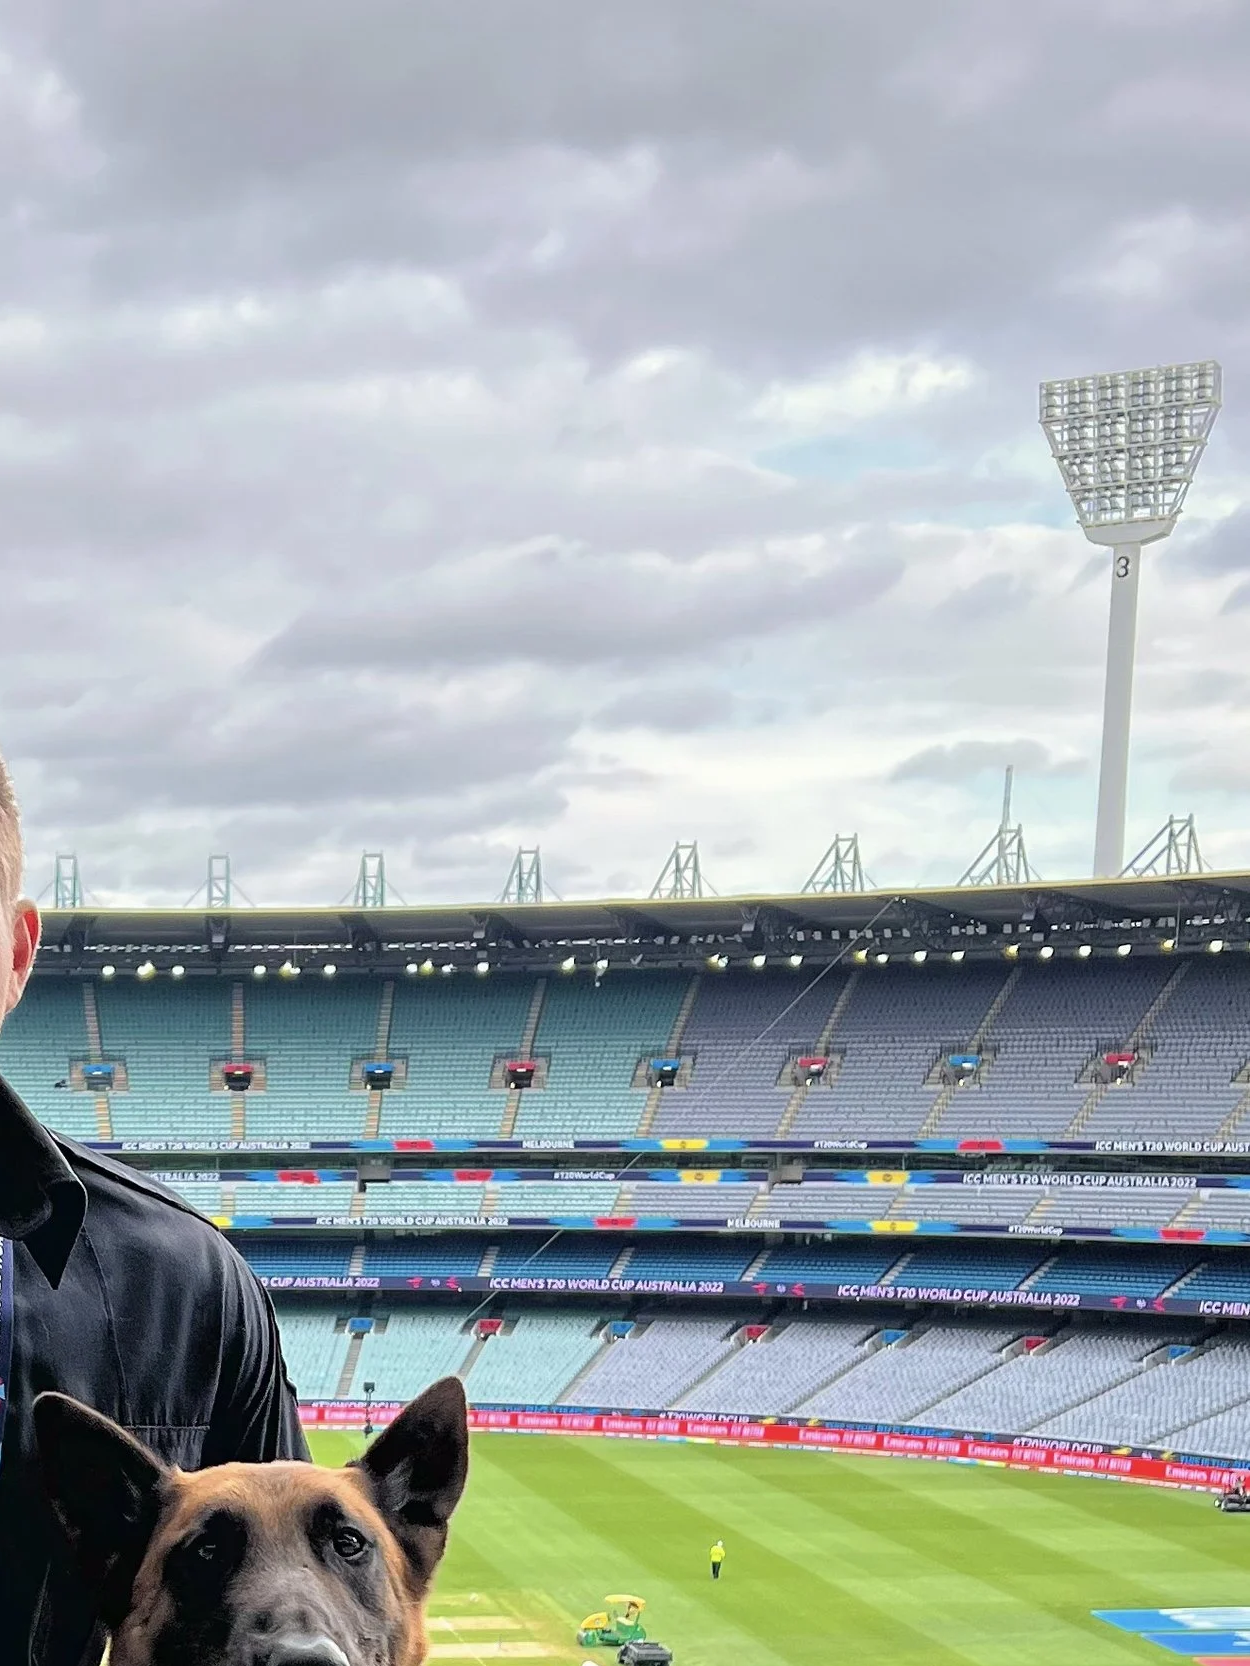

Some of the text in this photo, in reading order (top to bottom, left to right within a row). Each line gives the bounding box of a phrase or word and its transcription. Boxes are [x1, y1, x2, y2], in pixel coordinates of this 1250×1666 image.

[1116, 555, 1130, 578] 3
[522, 1140, 575, 1149] MELBOURNE
[1095, 1141, 1111, 1151] ICC
[1145, 1142, 1162, 1151] T20
[1164, 1142, 1201, 1152] WORLD
[1203, 1142, 1223, 1152] CUP
[963, 1174, 981, 1184] ICC
[1019, 1175, 1038, 1185] T20
[1040, 1175, 1081, 1186] WORLD
[1083, 1176, 1105, 1186] CUP
[1107, 1176, 1170, 1188] AUSTRALIA
[1171, 1178, 1197, 1188] 2022
[316, 1217, 332, 1226] ICC
[363, 1217, 378, 1226] T20
[380, 1217, 413, 1226] WORLD
[415, 1217, 433, 1226] CUP
[435, 1217, 486, 1226] AUSTRALIA
[487, 1217, 508, 1226] 2022
[270, 1278, 293, 1288] CUP
[294, 1278, 353, 1288] AUSTRALIA
[355, 1278, 380, 1288] 2022
[490, 1278, 509, 1289] ICC
[547, 1279, 565, 1290] T20
[567, 1280, 610, 1290] WORLD
[612, 1280, 634, 1291] CUP
[635, 1281, 697, 1292] AUSTRALIA
[698, 1282, 724, 1292] 2022
[838, 1285, 858, 1297] ICC
[896, 1287, 916, 1299] T20
[918, 1288, 961, 1301] WORLD
[964, 1290, 988, 1302] CUP
[990, 1291, 1051, 1305] AUSTRALIA
[1053, 1294, 1080, 1306] 2022
[1200, 1300, 1221, 1314] ICC
